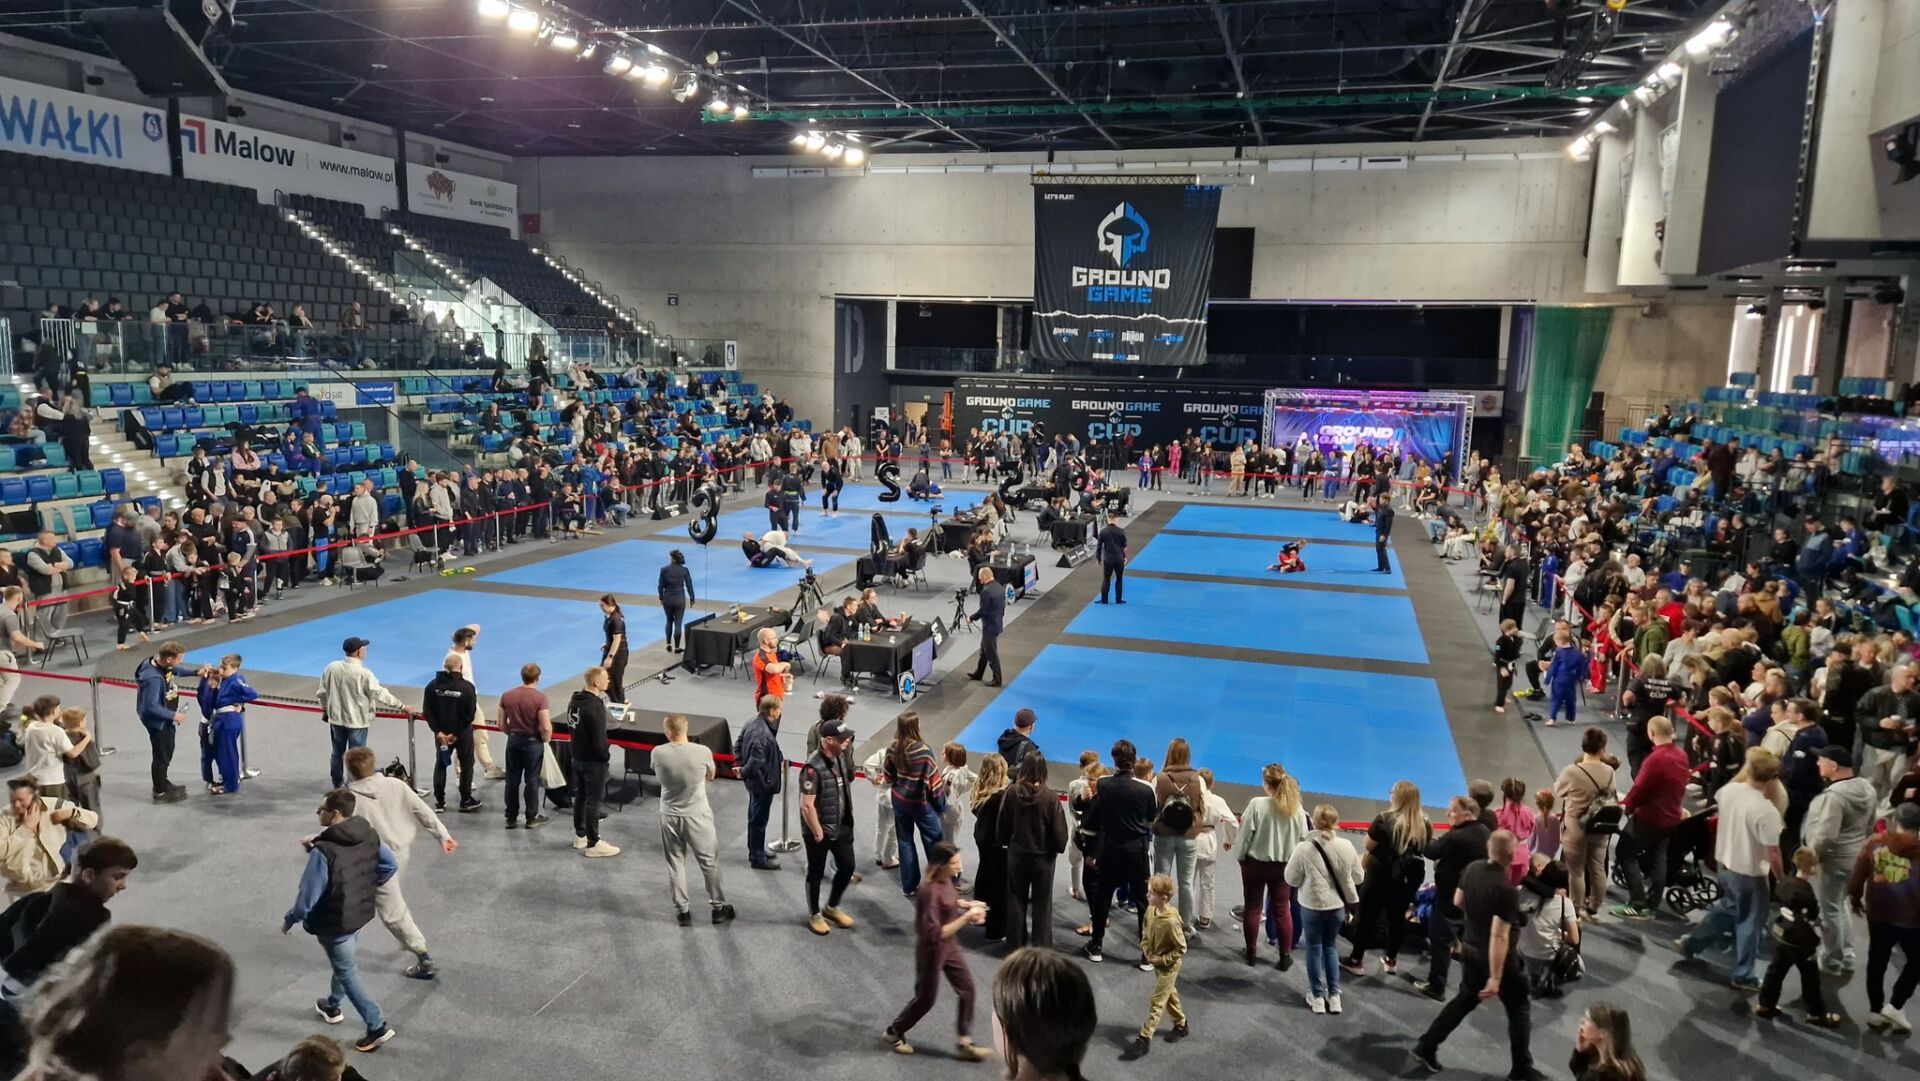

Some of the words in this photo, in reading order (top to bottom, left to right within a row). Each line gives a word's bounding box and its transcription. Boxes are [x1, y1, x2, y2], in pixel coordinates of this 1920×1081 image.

[0, 94, 123, 159] WAŁKI
[214, 128, 295, 167] Malow
[319, 159, 394, 183] www.malow.pl
[1072, 265, 1171, 289] GROUND
[1087, 286, 1152, 303] GAME
[966, 396, 1051, 408] GROUNDGAME
[1072, 400, 1161, 412] GROUNDGAME
[1200, 426, 1257, 444] CUP
[1319, 425, 1394, 439] GROUND
